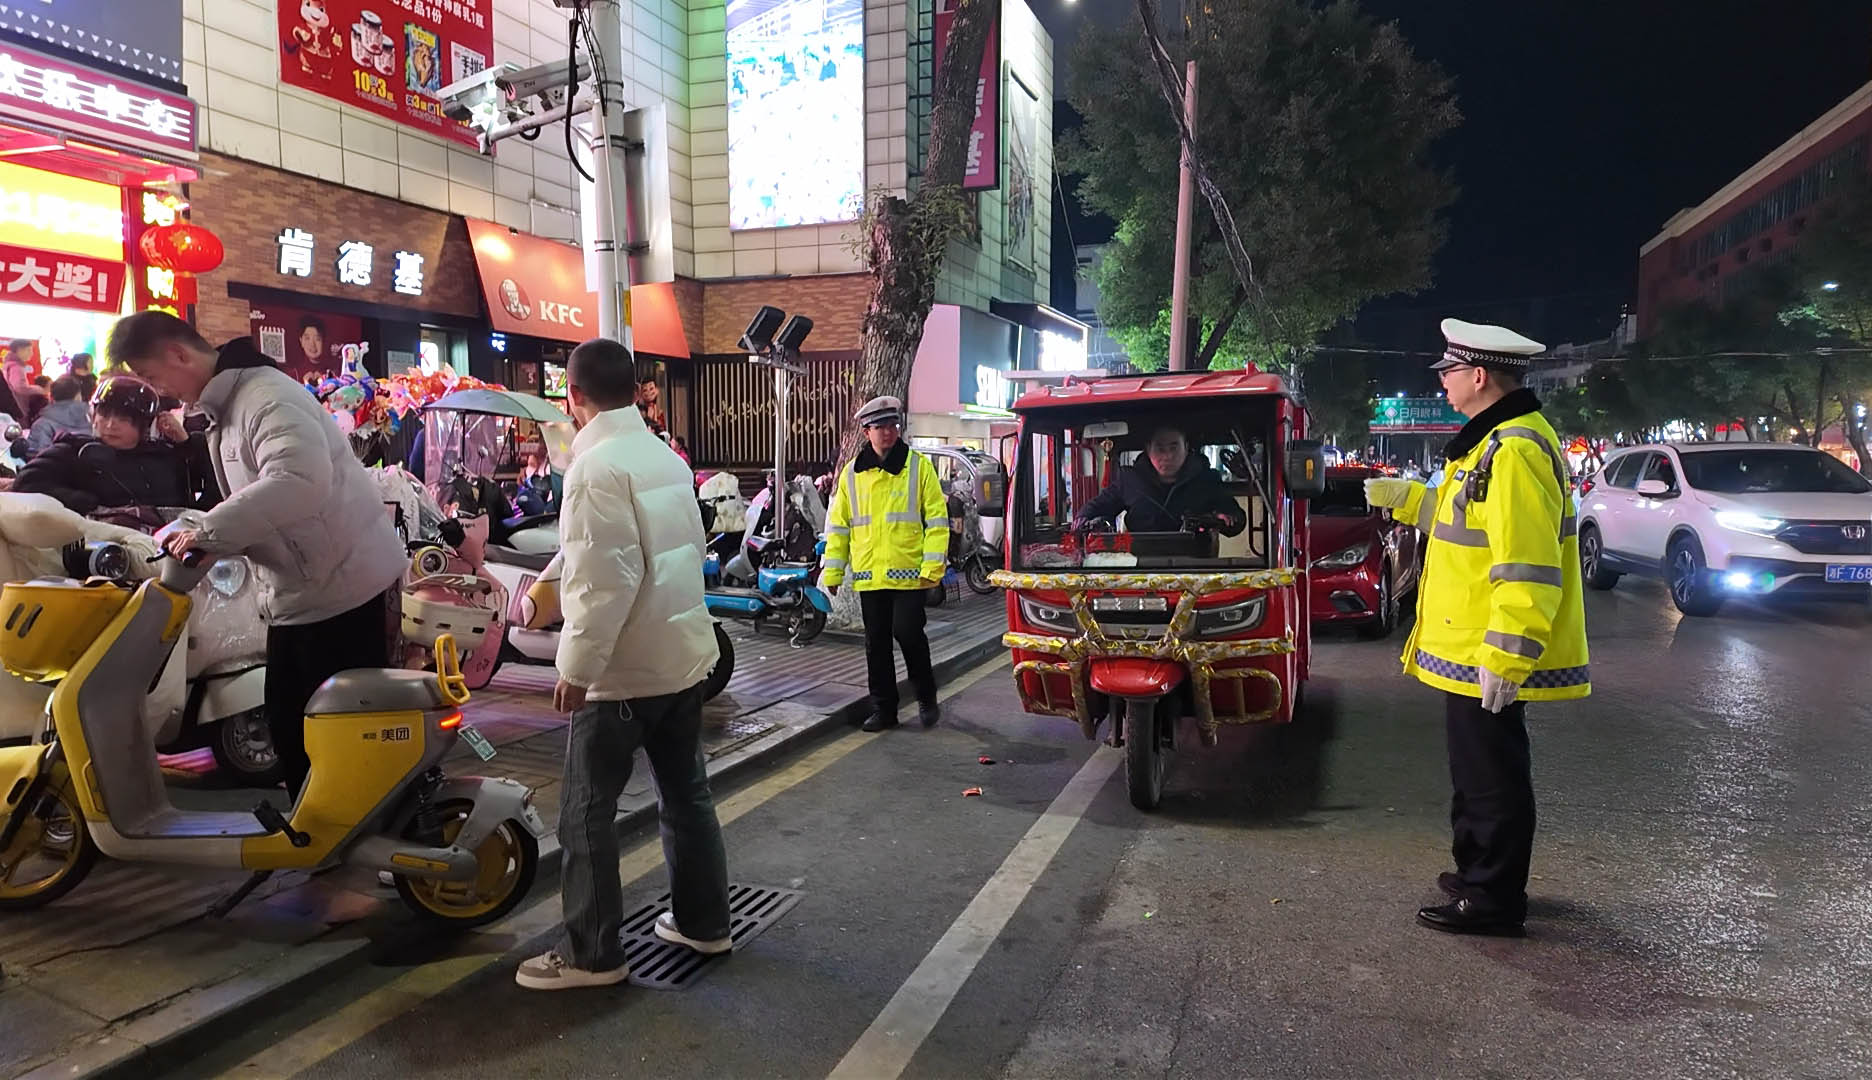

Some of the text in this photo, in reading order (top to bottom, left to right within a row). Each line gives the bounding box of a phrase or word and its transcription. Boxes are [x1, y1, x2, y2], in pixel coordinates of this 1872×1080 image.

[278, 228, 425, 296] 肯德基
[0, 256, 109, 302] 大奖!
[540, 299, 584, 328] KFC
[1399, 407, 1442, 418] 日月眼科
[381, 728, 410, 741] 美团
